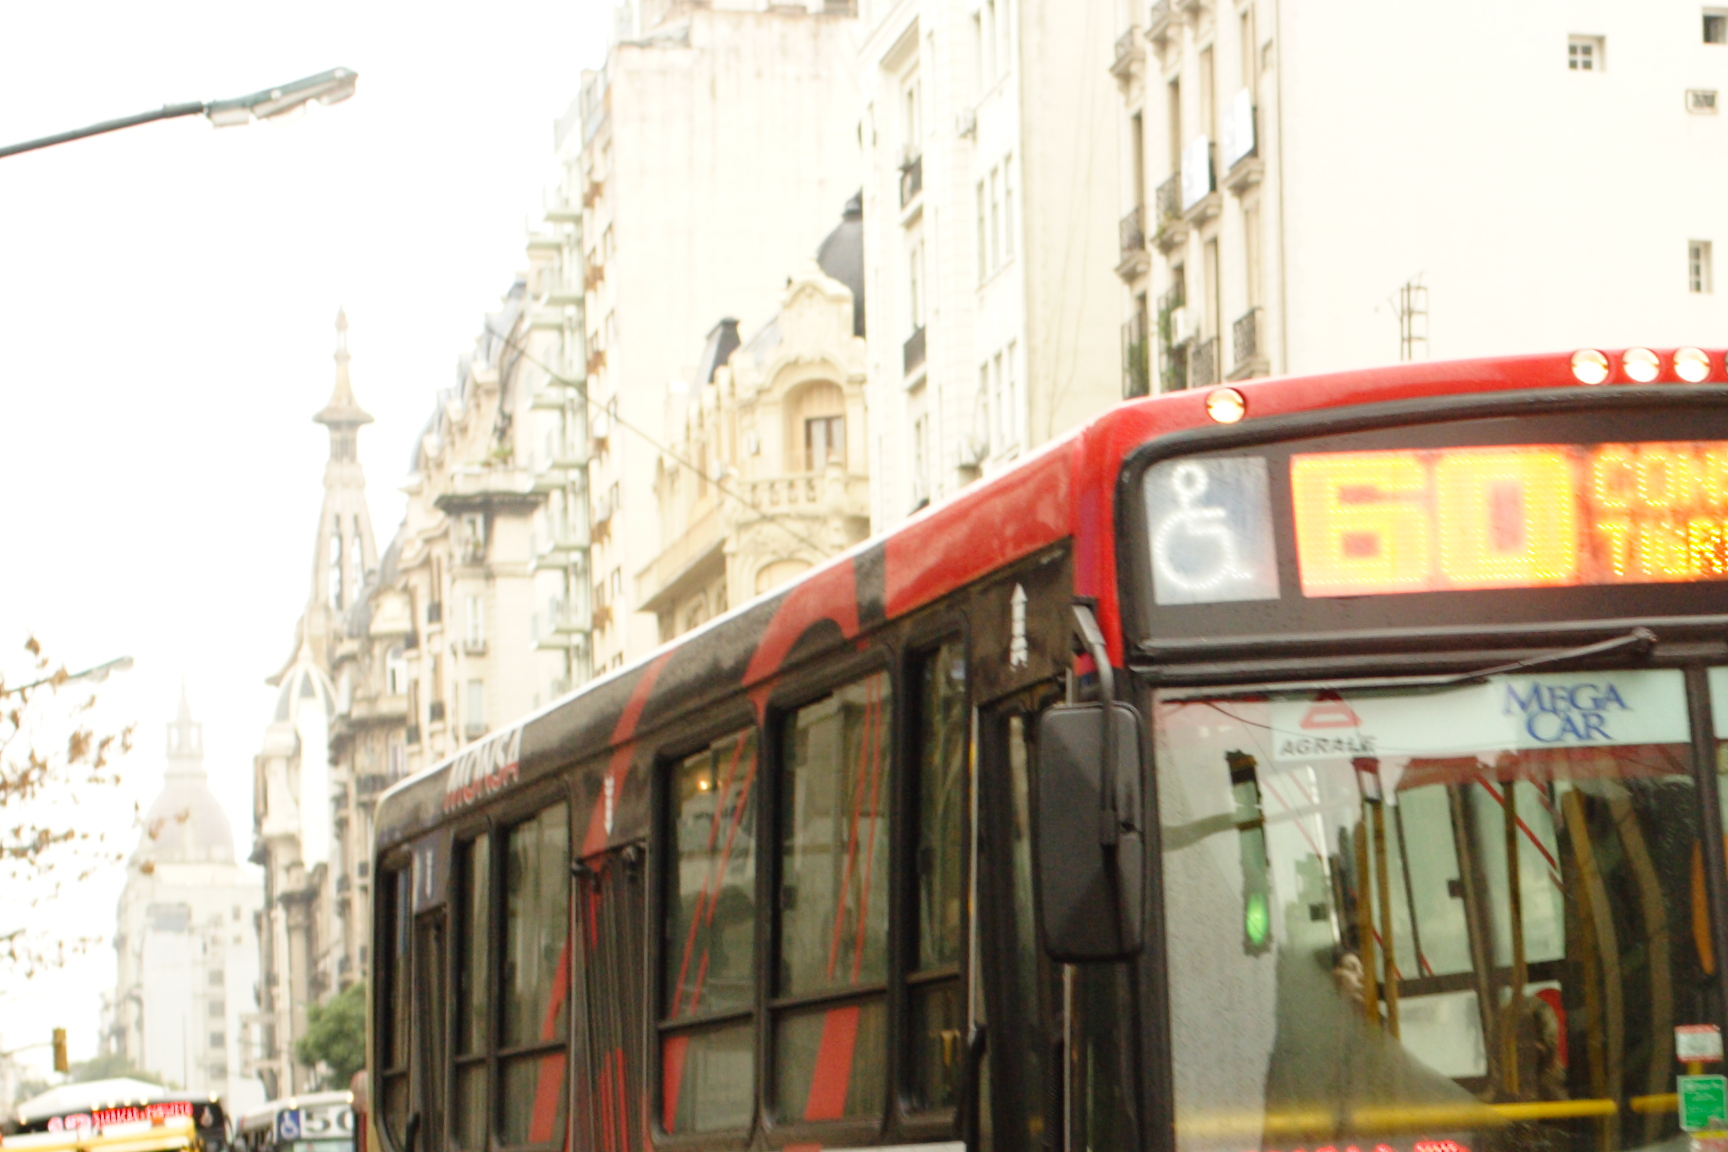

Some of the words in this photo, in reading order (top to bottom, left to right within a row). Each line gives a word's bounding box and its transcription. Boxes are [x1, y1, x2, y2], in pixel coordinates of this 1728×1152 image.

[1294, 447, 1577, 589] 60
[1504, 681, 1630, 716] MEGA
[1526, 713, 1613, 744] CAR
[1279, 736, 1377, 757] AGRALE
